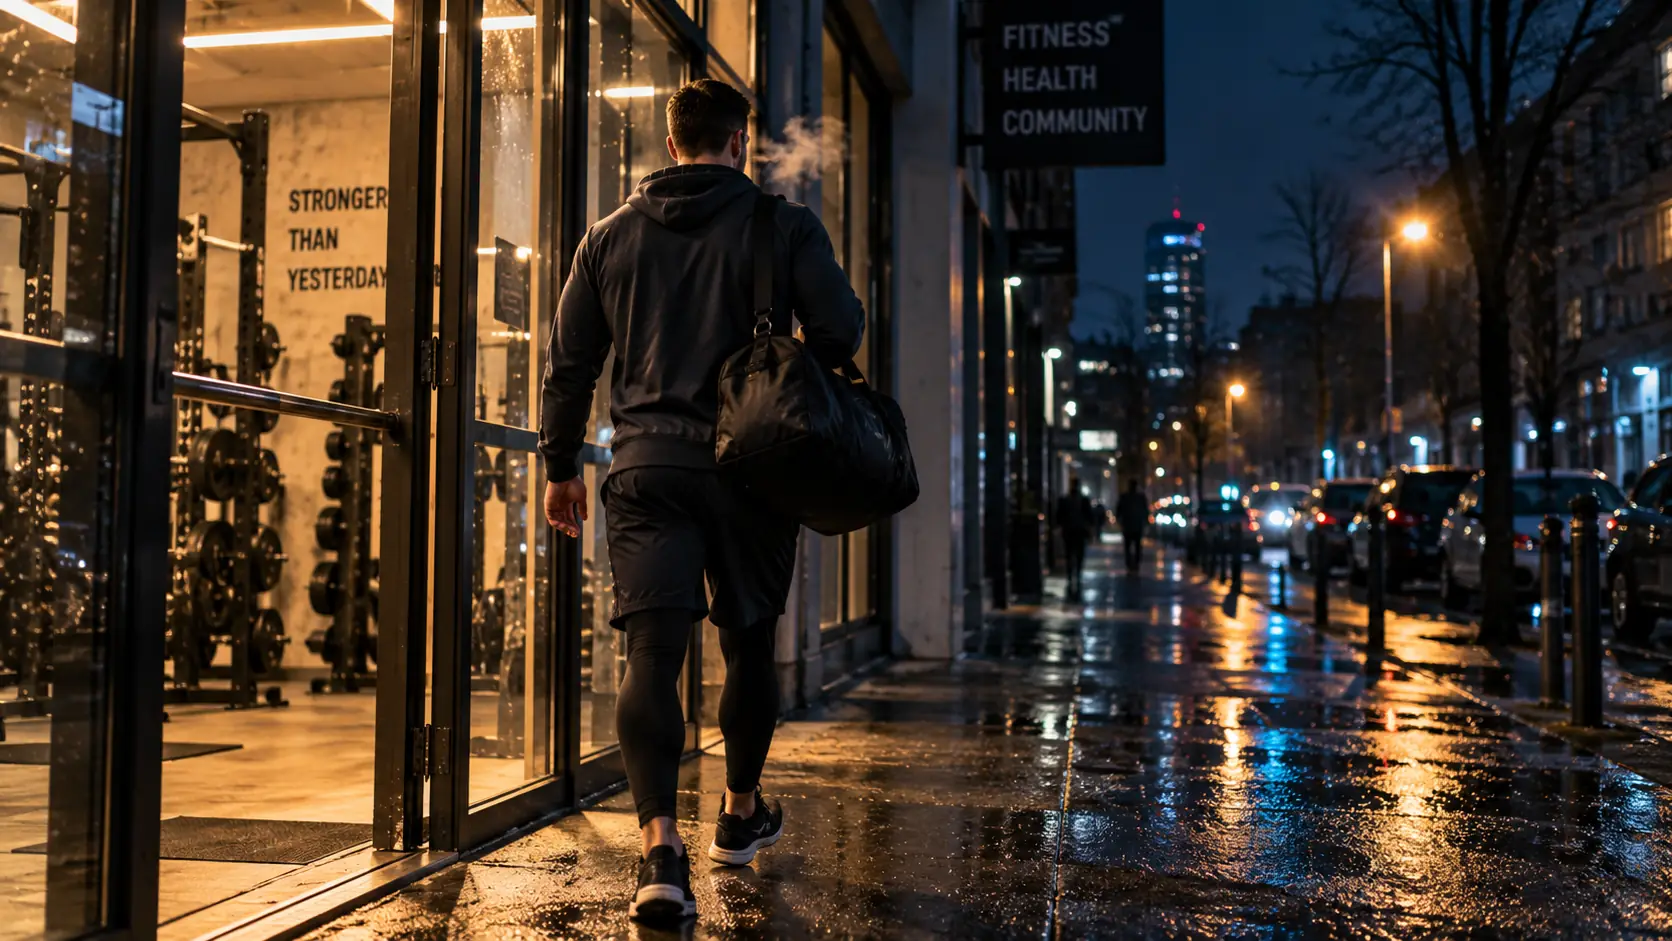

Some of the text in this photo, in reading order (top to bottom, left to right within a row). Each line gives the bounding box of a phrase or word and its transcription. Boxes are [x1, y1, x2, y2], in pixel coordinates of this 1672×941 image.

[1003, 21, 1110, 49] FITNESS
[1003, 65, 1097, 92] HEALTH
[1002, 106, 1148, 136] COMMUNITY
[289, 186, 387, 213] STRONGER
[288, 227, 338, 251] THAN
